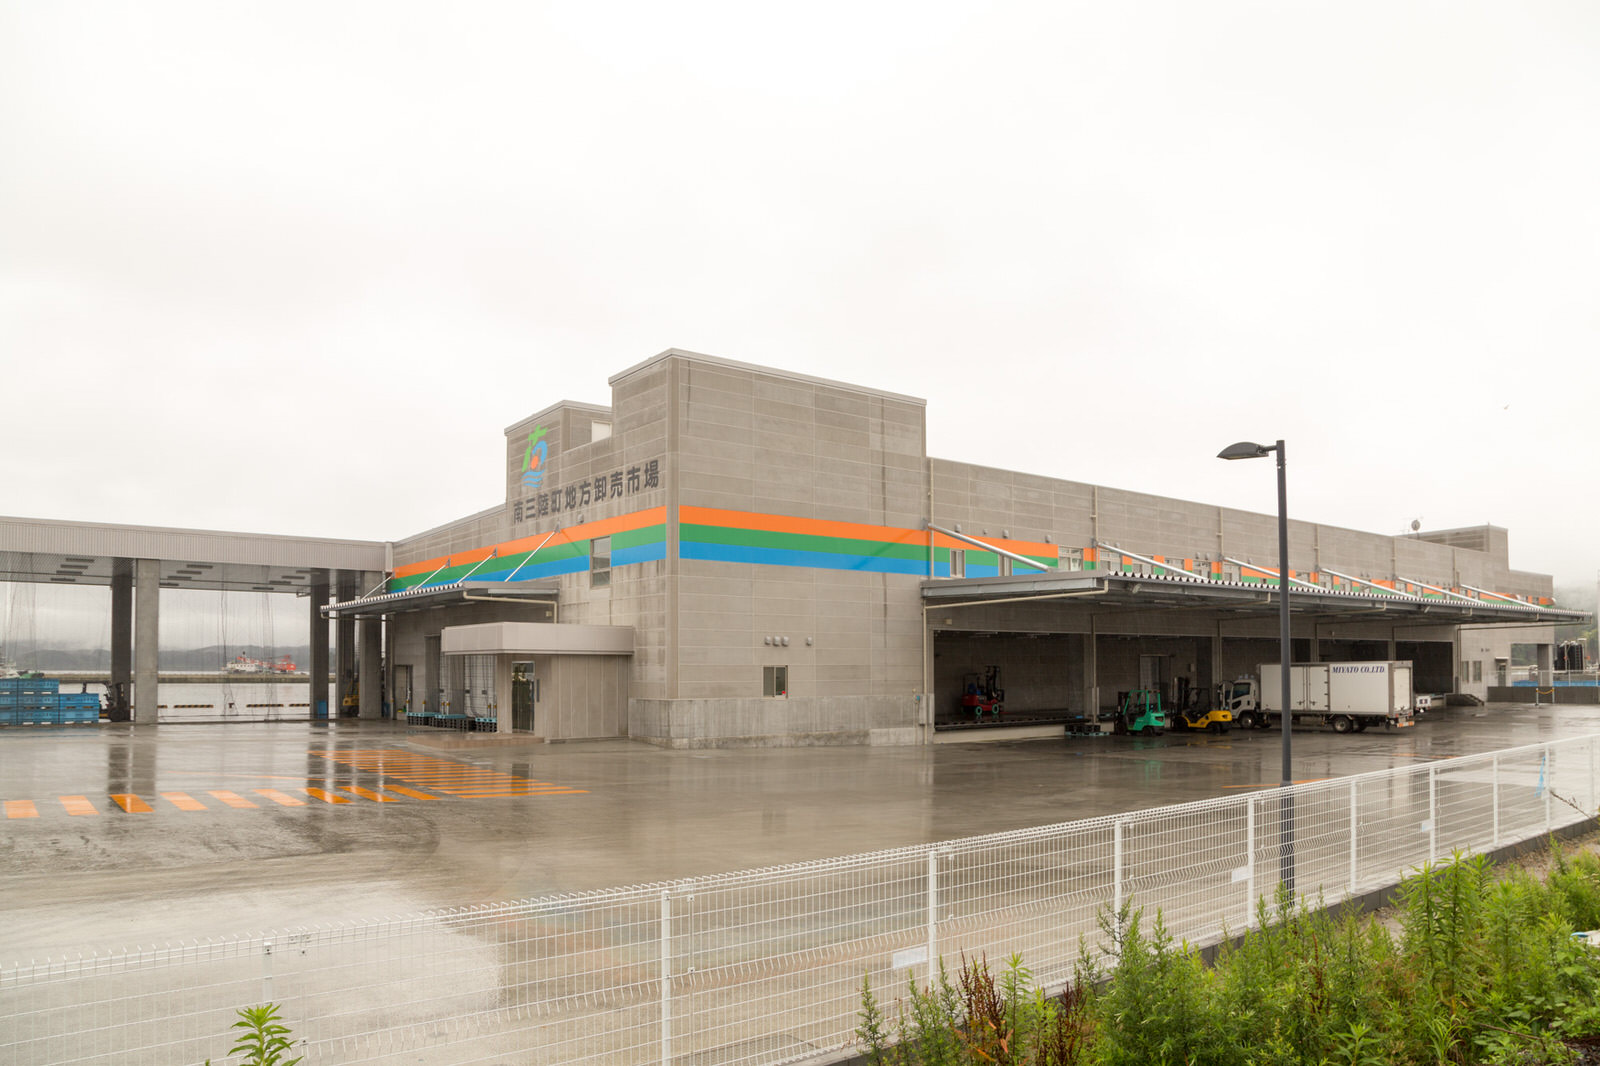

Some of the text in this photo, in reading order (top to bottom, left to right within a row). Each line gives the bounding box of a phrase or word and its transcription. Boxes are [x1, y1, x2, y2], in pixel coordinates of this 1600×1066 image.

[513, 459, 660, 523] 南三陸町地方卸売市場
